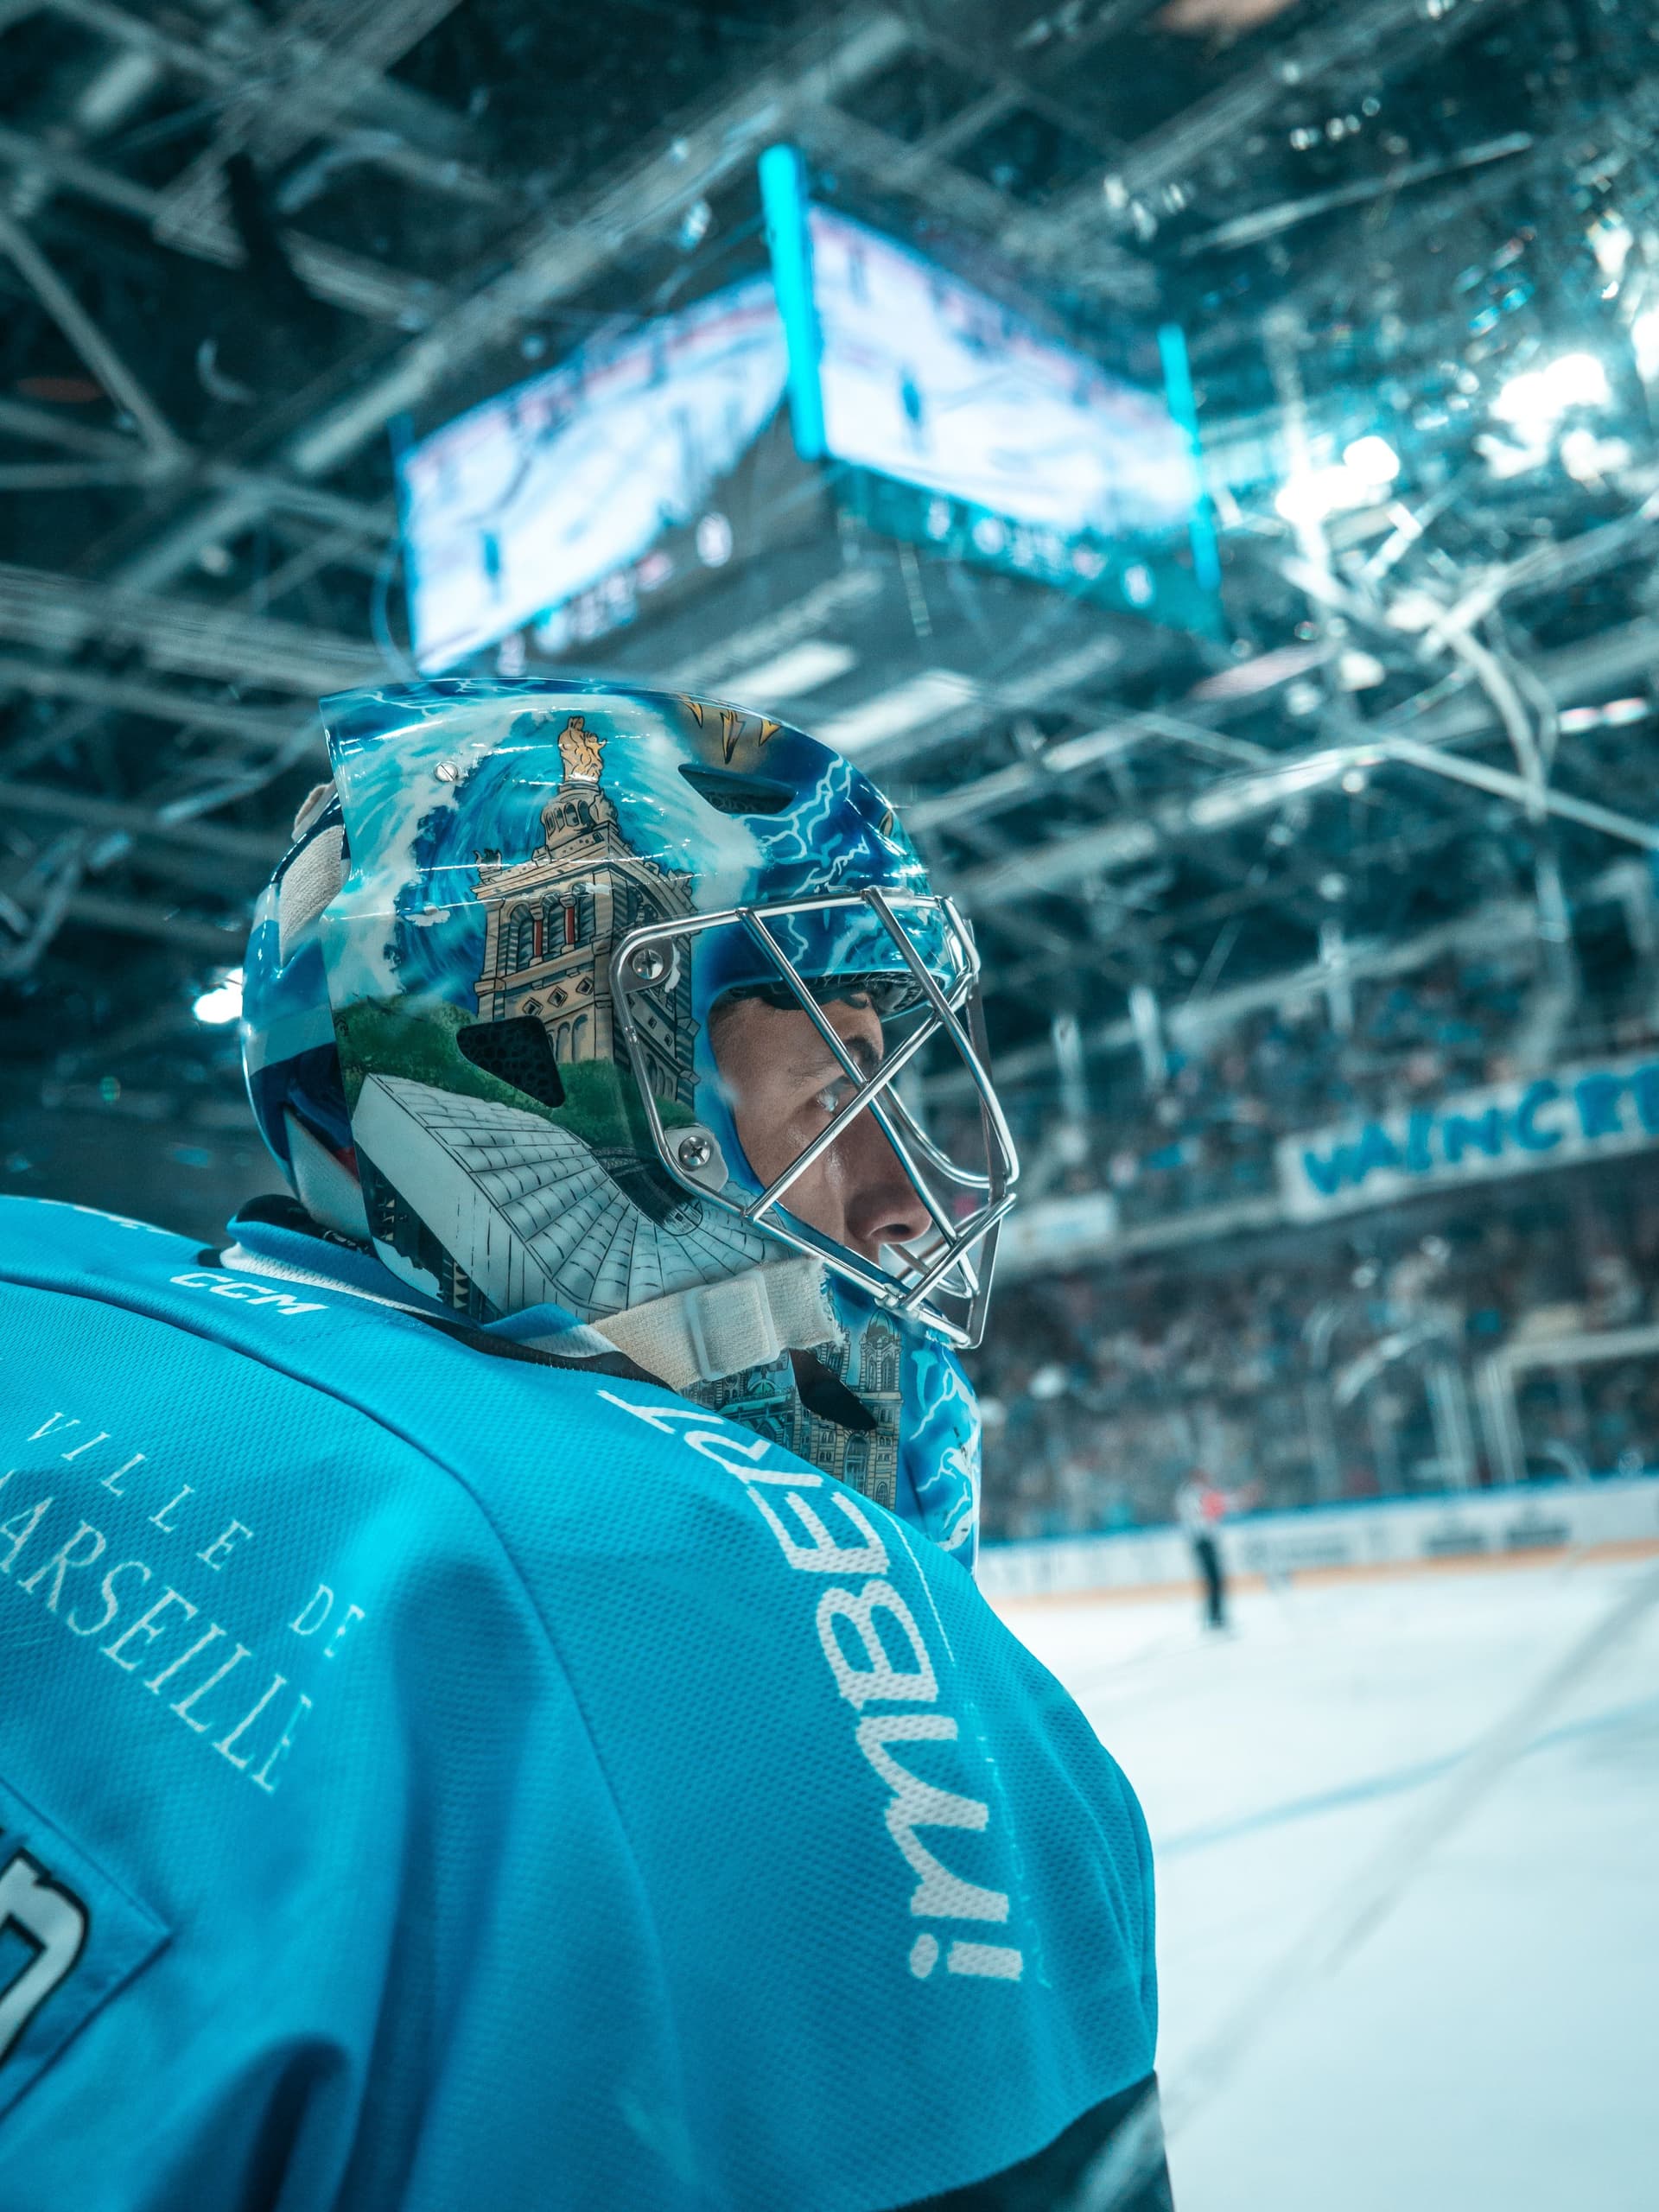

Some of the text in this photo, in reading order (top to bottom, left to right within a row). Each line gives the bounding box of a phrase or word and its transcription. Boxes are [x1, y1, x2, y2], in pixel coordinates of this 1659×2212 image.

[169, 1272, 329, 1315] CCM
[27, 1412, 252, 1571] VILLE
[0, 1470, 312, 1794] ARSEILLE
